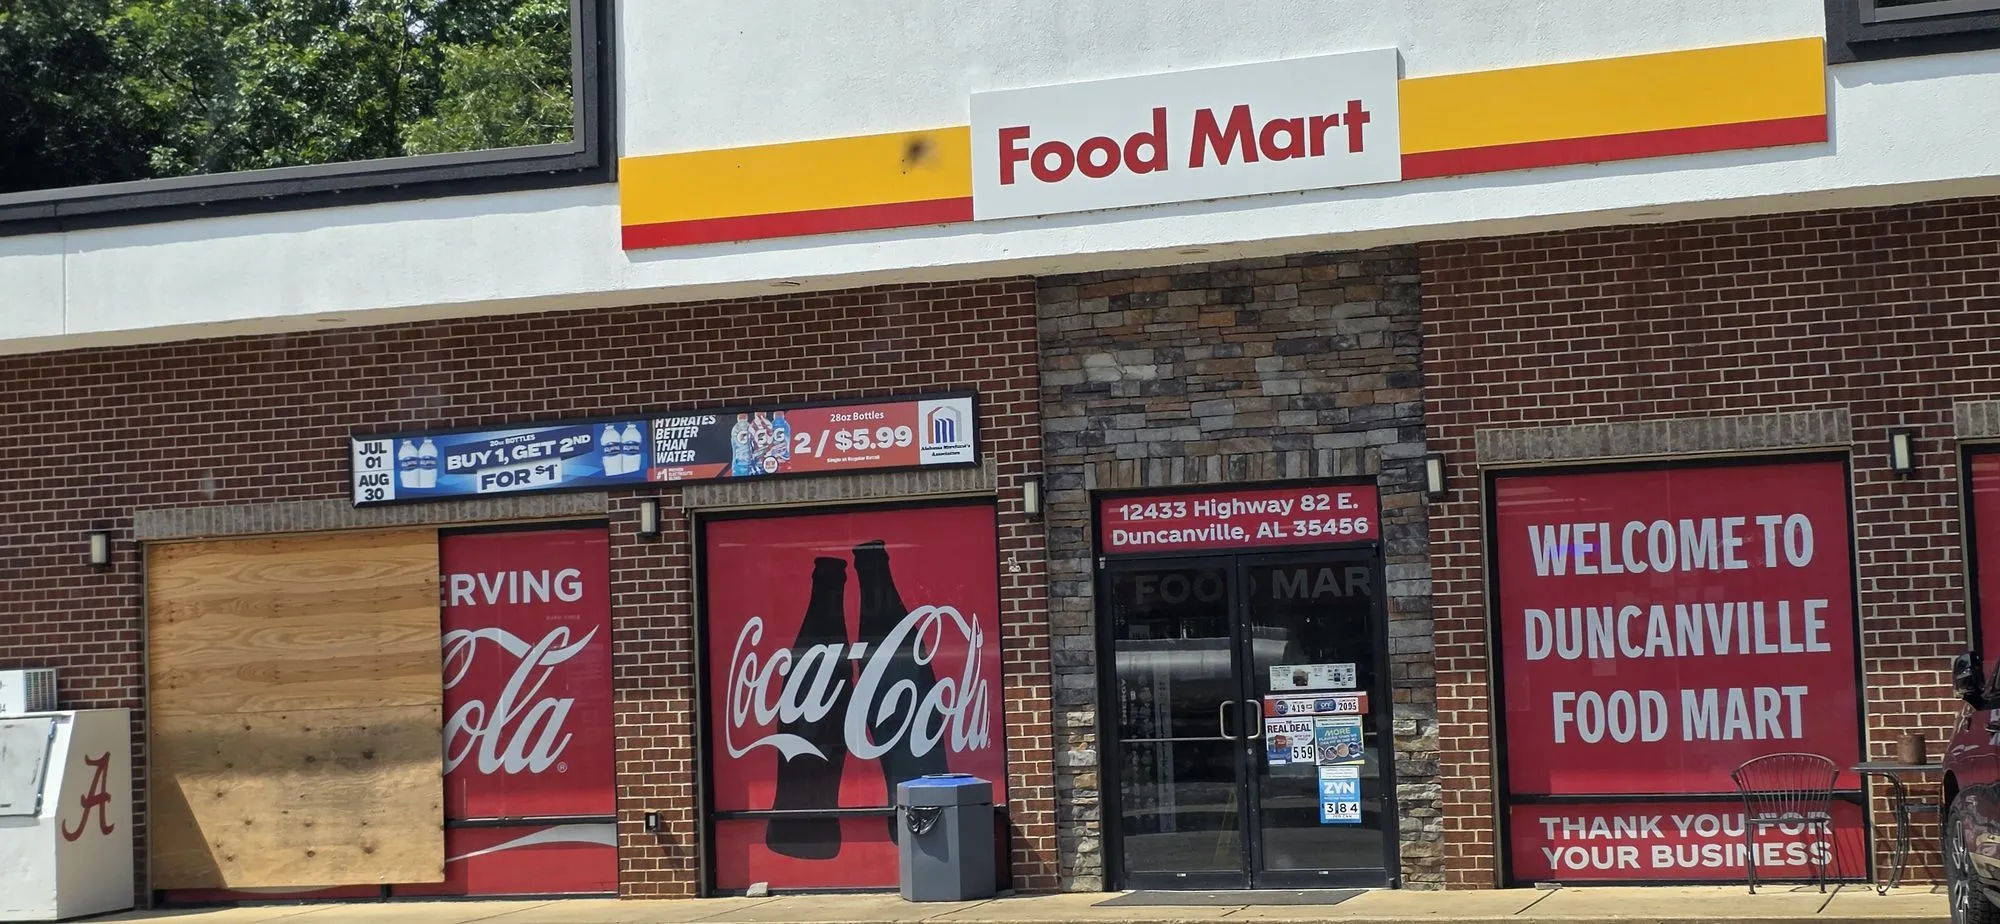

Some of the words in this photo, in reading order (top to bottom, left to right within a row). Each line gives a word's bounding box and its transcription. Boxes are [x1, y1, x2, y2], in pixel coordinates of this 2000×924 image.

[998, 106, 1169, 186] Food
[1188, 99, 1371, 168] Mart
[655, 414, 716, 428] HYDRATES
[830, 413, 851, 422] 28oz
[853, 411, 884, 421] Bottles
[505, 434, 536, 445] BOTTLES
[656, 427, 699, 440] BETTER
[794, 432, 811, 454] 2
[835, 425, 913, 453] $5.99
[358, 442, 387, 455] JUL
[447, 450, 491, 470] BUY
[512, 440, 557, 460] GET
[559, 434, 592, 453] 2ND
[656, 439, 688, 452] THAN
[365, 456, 382, 469] 01
[657, 450, 696, 464] WATER
[358, 473, 390, 487] AUG
[481, 470, 531, 491] FOR
[364, 487, 384, 500] 30
[1119, 501, 1187, 521] 12433
[1194, 496, 1295, 520] Highway
[1300, 494, 1330, 512] 82
[1338, 492, 1359, 510] E.
[1112, 523, 1250, 546] Duncanville,
[1256, 521, 1288, 539] AL
[1293, 517, 1369, 537] 35456
[1528, 516, 1748, 577] WELCOME
[1756, 513, 1815, 569] TO
[1524, 598, 1832, 661] DUNCANVILLE
[726, 605, 990, 763] Coca-Cola
[1552, 690, 1668, 744] FOOD
[1680, 685, 1809, 742] MART
[1267, 725, 1289, 734] REAL
[1290, 723, 1311, 732] DEAL
[1324, 728, 1351, 737] MORE
[1323, 781, 1355, 794] ZYN
[62, 751, 115, 842] A
[1539, 815, 1665, 840] THANK
[1671, 813, 1746, 839] YOU
[1758, 811, 1833, 836] FOR
[1541, 846, 1641, 870] YOUR
[1652, 841, 1833, 869] BUSINESS
